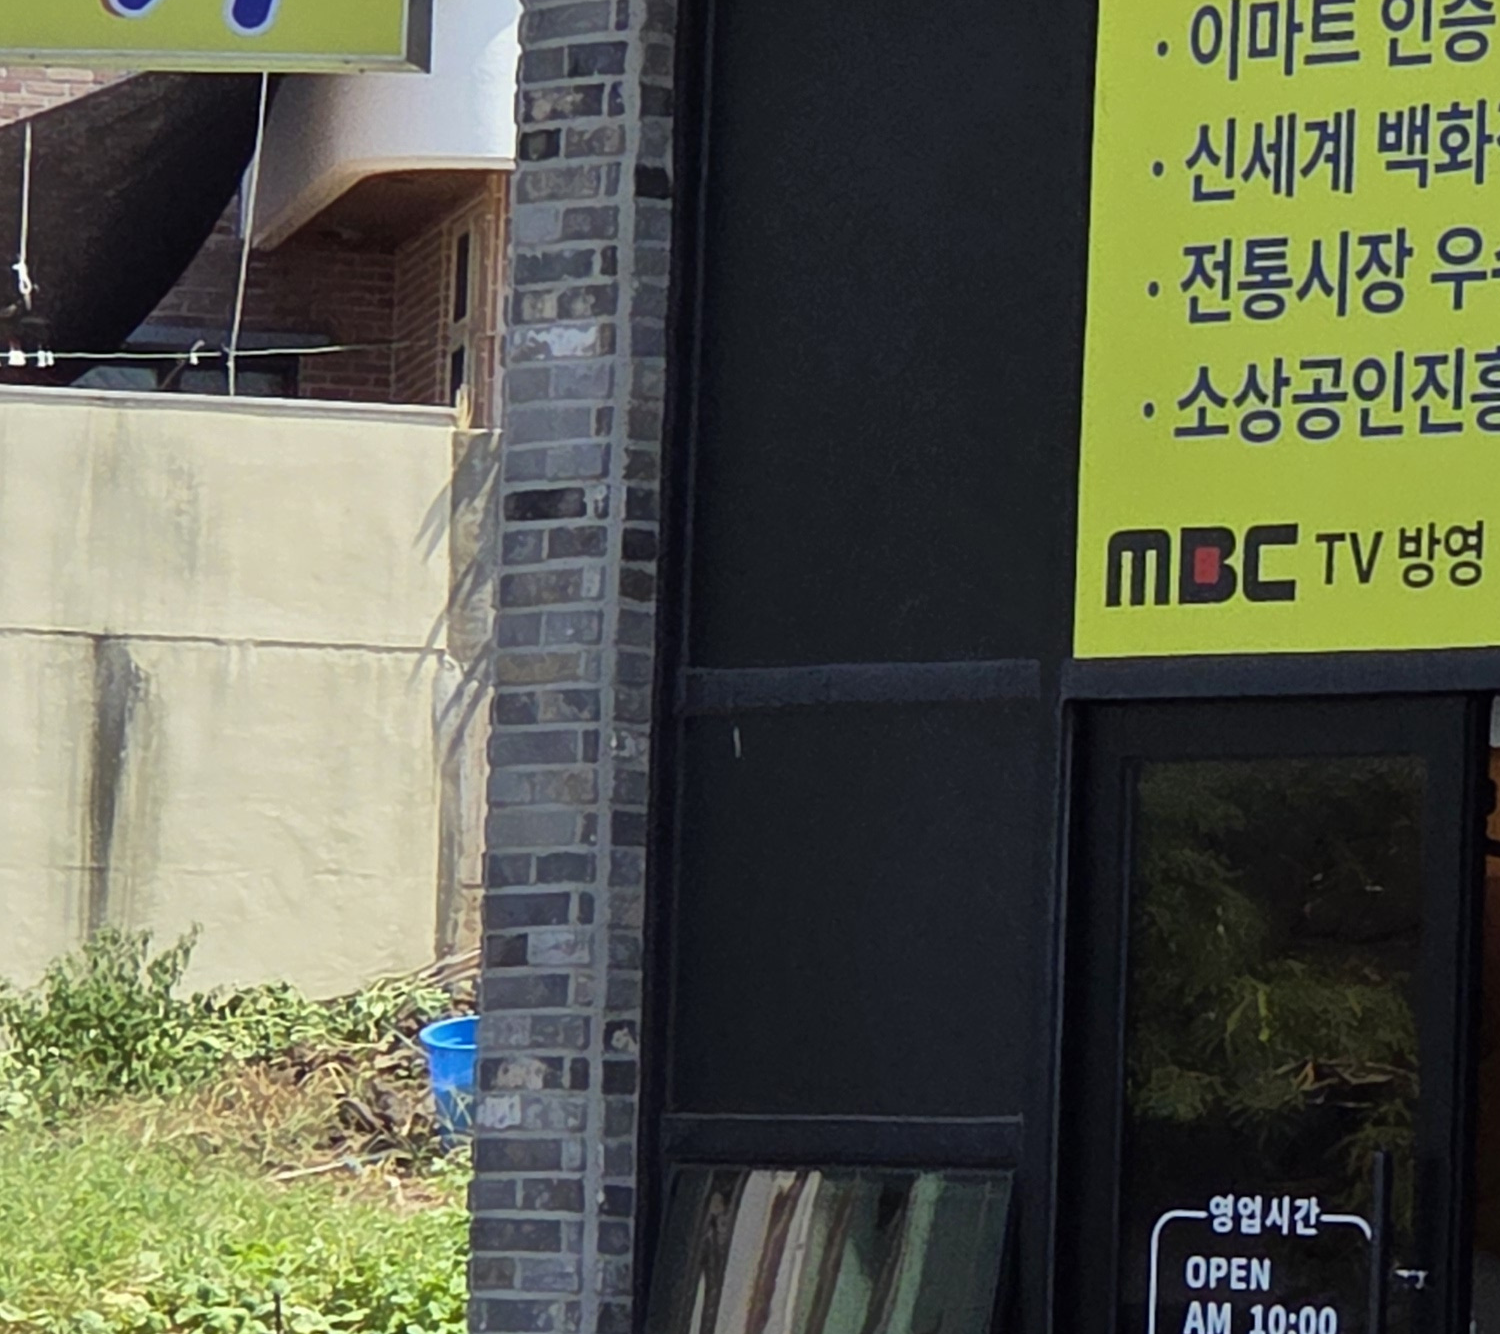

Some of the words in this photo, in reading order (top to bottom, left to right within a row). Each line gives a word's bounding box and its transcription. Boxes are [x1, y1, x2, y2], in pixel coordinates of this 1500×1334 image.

[1184, 109, 1358, 202] 신세계
[1178, 227, 1414, 324] 전통시장
[1105, 522, 1300, 608] MBC
[1315, 530, 1384, 586] TV
[1399, 520, 1486, 589] 방영
[1208, 1194, 1321, 1237] 영업시간
[1185, 1255, 1272, 1292] OPEN
